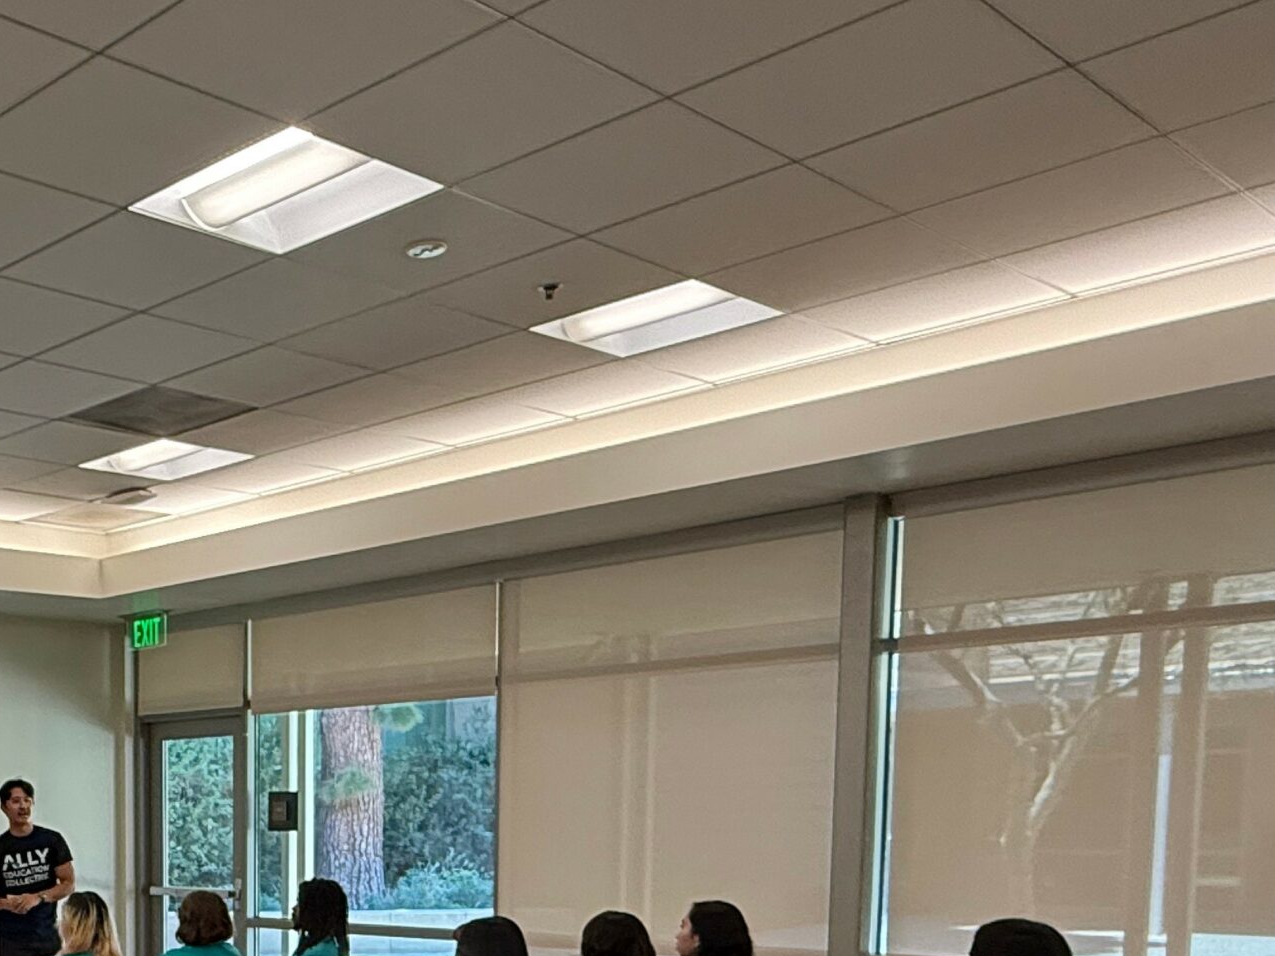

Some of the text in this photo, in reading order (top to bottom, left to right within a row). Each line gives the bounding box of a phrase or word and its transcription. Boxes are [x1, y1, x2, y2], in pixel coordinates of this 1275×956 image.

[134, 617, 161, 648] EXIT
[2, 848, 49, 871] ALLY
[2, 865, 50, 879] EDUCATION
[5, 872, 49, 887] COLLECTIVE
